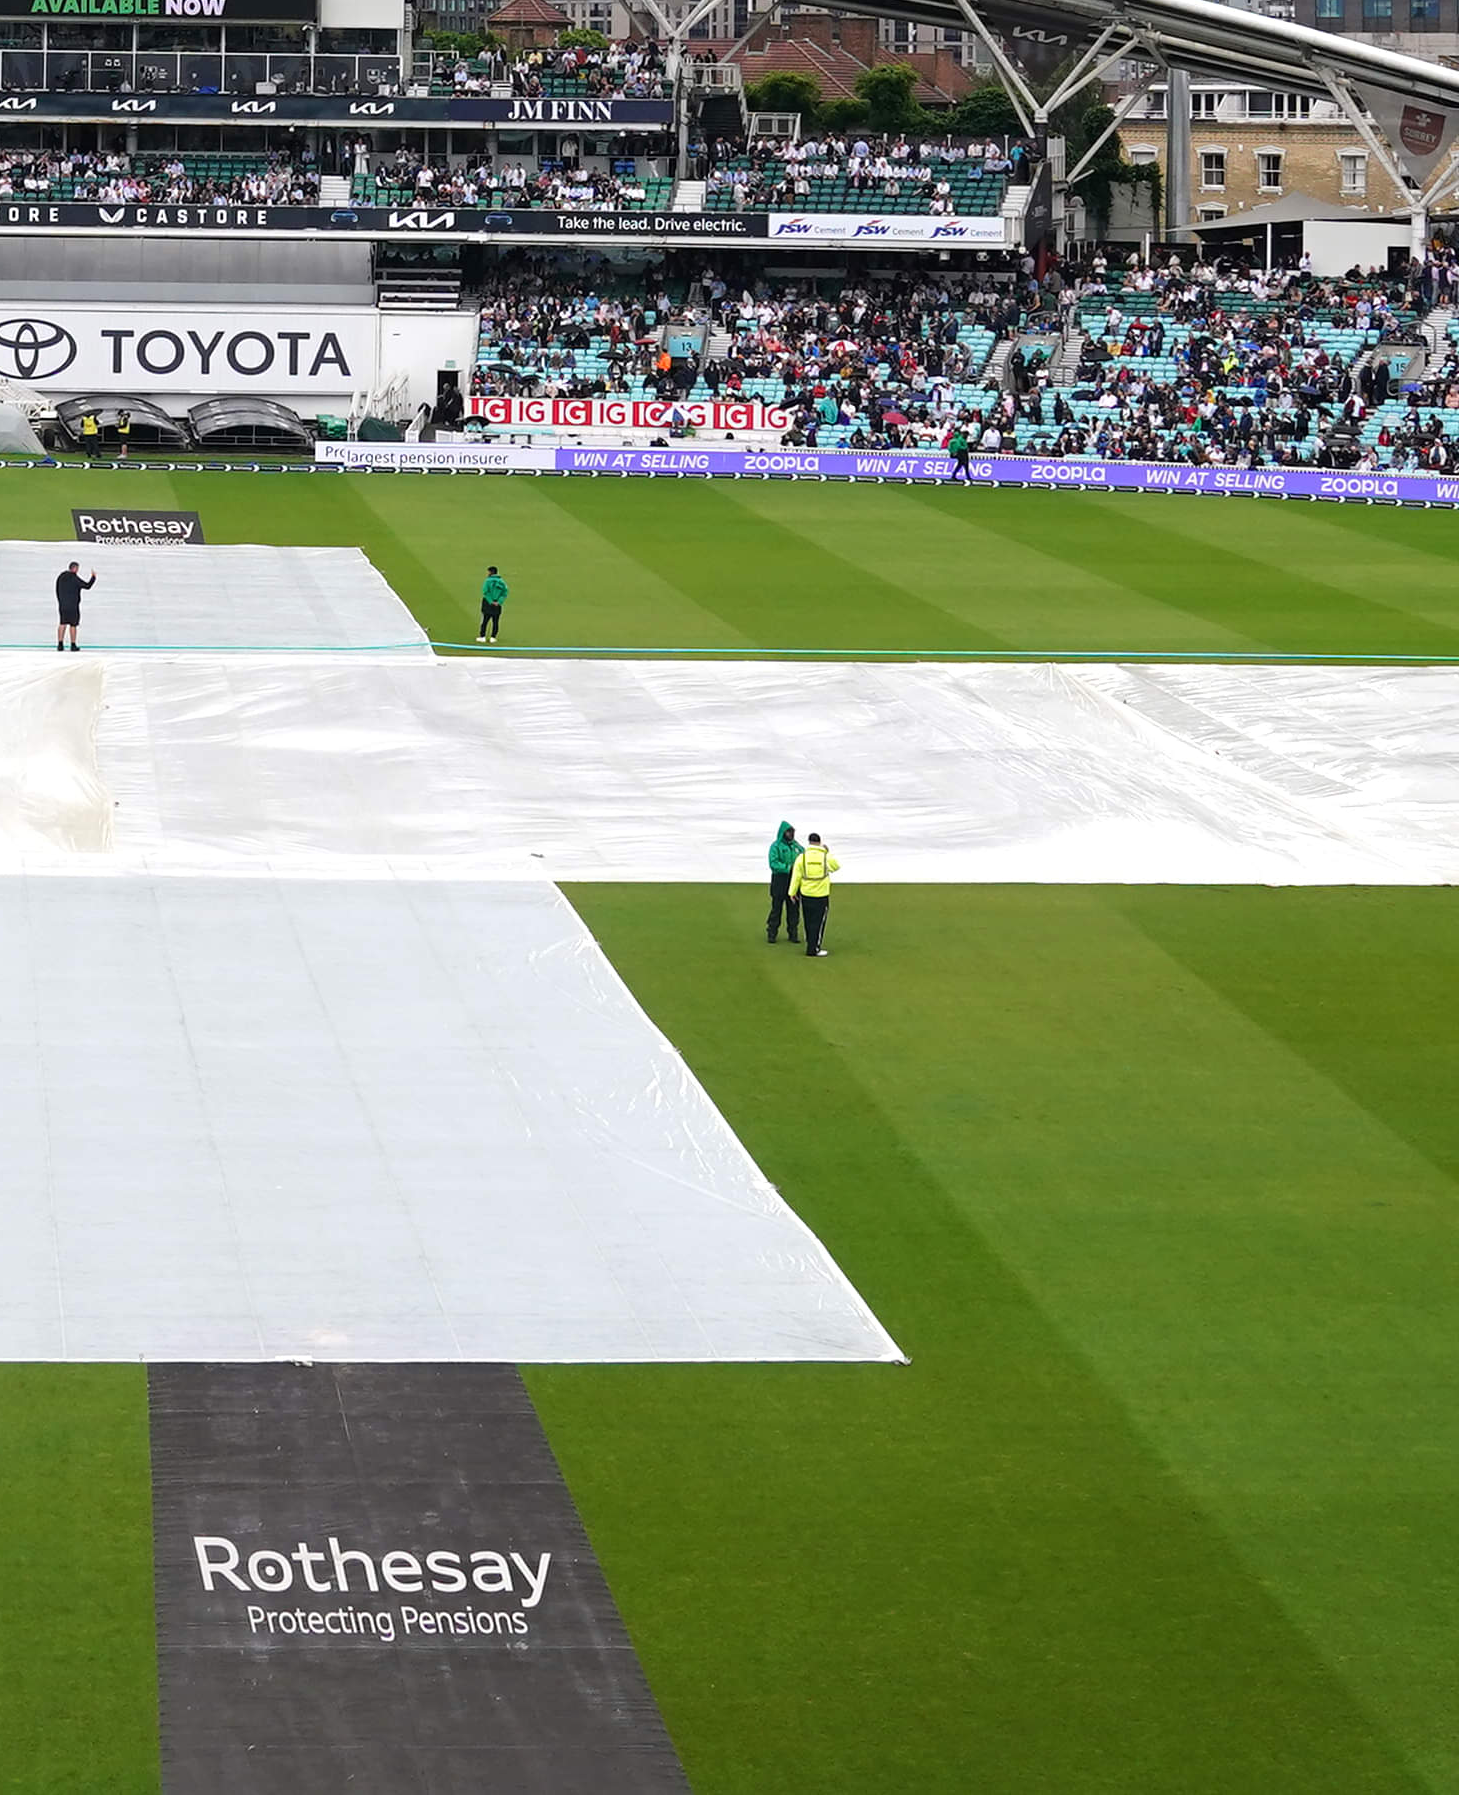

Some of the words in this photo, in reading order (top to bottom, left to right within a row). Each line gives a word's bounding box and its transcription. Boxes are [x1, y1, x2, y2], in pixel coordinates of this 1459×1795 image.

[508, 101, 547, 120] JM
[550, 102, 613, 120] FINN
[136, 209, 267, 225] CASTORE
[814, 226, 846, 234] Cement
[892, 227, 924, 235] Cement
[101, 329, 352, 376] TOYOTA
[347, 450, 397, 466] largest
[399, 451, 455, 466] pension
[459, 452, 509, 465] insurer
[1147, 469, 1180, 486] WIN
[1184, 471, 1210, 486] AT
[1214, 473, 1285, 490] SELLING
[79, 515, 195, 538] Rothesay
[192, 1535, 553, 1609] Rothesay
[246, 1604, 395, 1642] Protecting
[402, 1606, 529, 1636] Pensions
